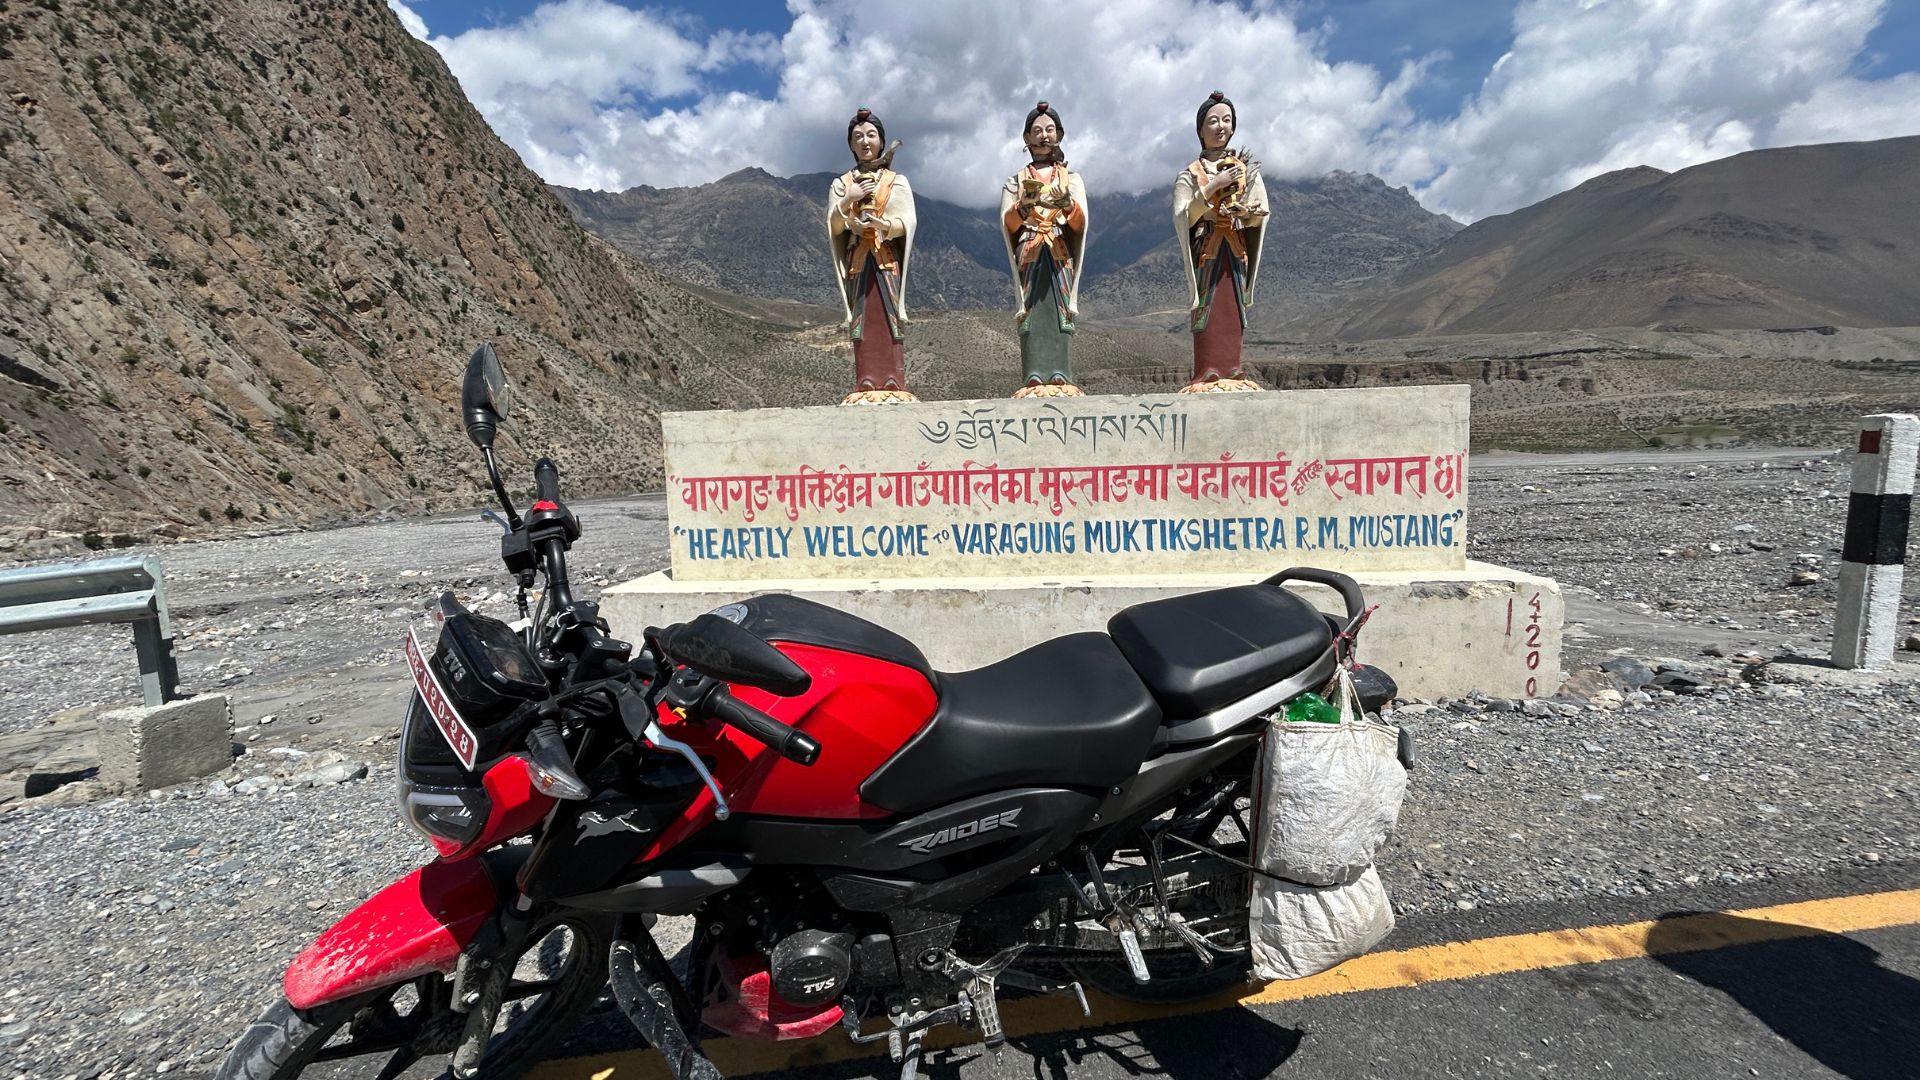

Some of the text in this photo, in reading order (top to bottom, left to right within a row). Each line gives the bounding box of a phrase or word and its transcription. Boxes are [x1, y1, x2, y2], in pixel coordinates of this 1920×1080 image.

[1038, 464, 1173, 517] मुस्ताङमा
[1177, 451, 1292, 507] यहाँलाई
[1324, 456, 1431, 501] स्वागत
[803, 523, 930, 558] WELCOME
[951, 521, 1076, 556] VARAGUNG
[1084, 517, 1287, 554] MUKTIKSHETRA
[443, 647, 468, 683] TVS
[897, 806, 1023, 854] RAIDER
[803, 977, 836, 994] TVS
